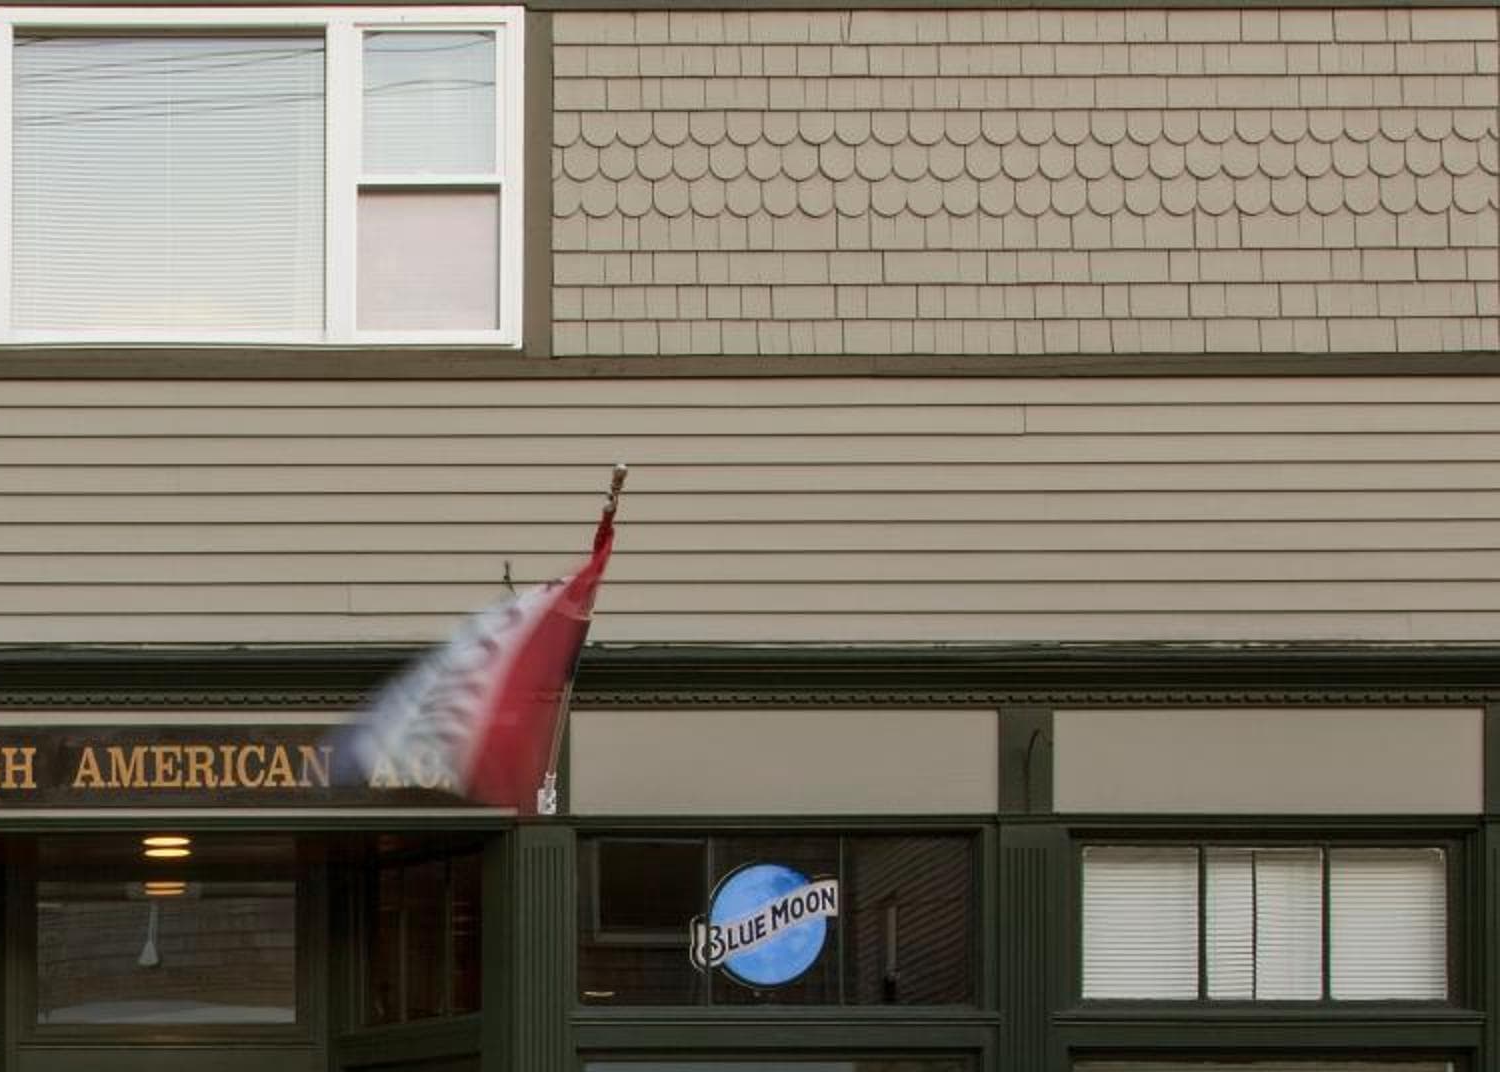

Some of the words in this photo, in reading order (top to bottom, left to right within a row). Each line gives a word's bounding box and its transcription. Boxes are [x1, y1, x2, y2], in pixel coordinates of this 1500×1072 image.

[73, 745, 333, 790] AMERICAN
[701, 914, 766, 961] BLUE
[772, 887, 835, 931] MOON
